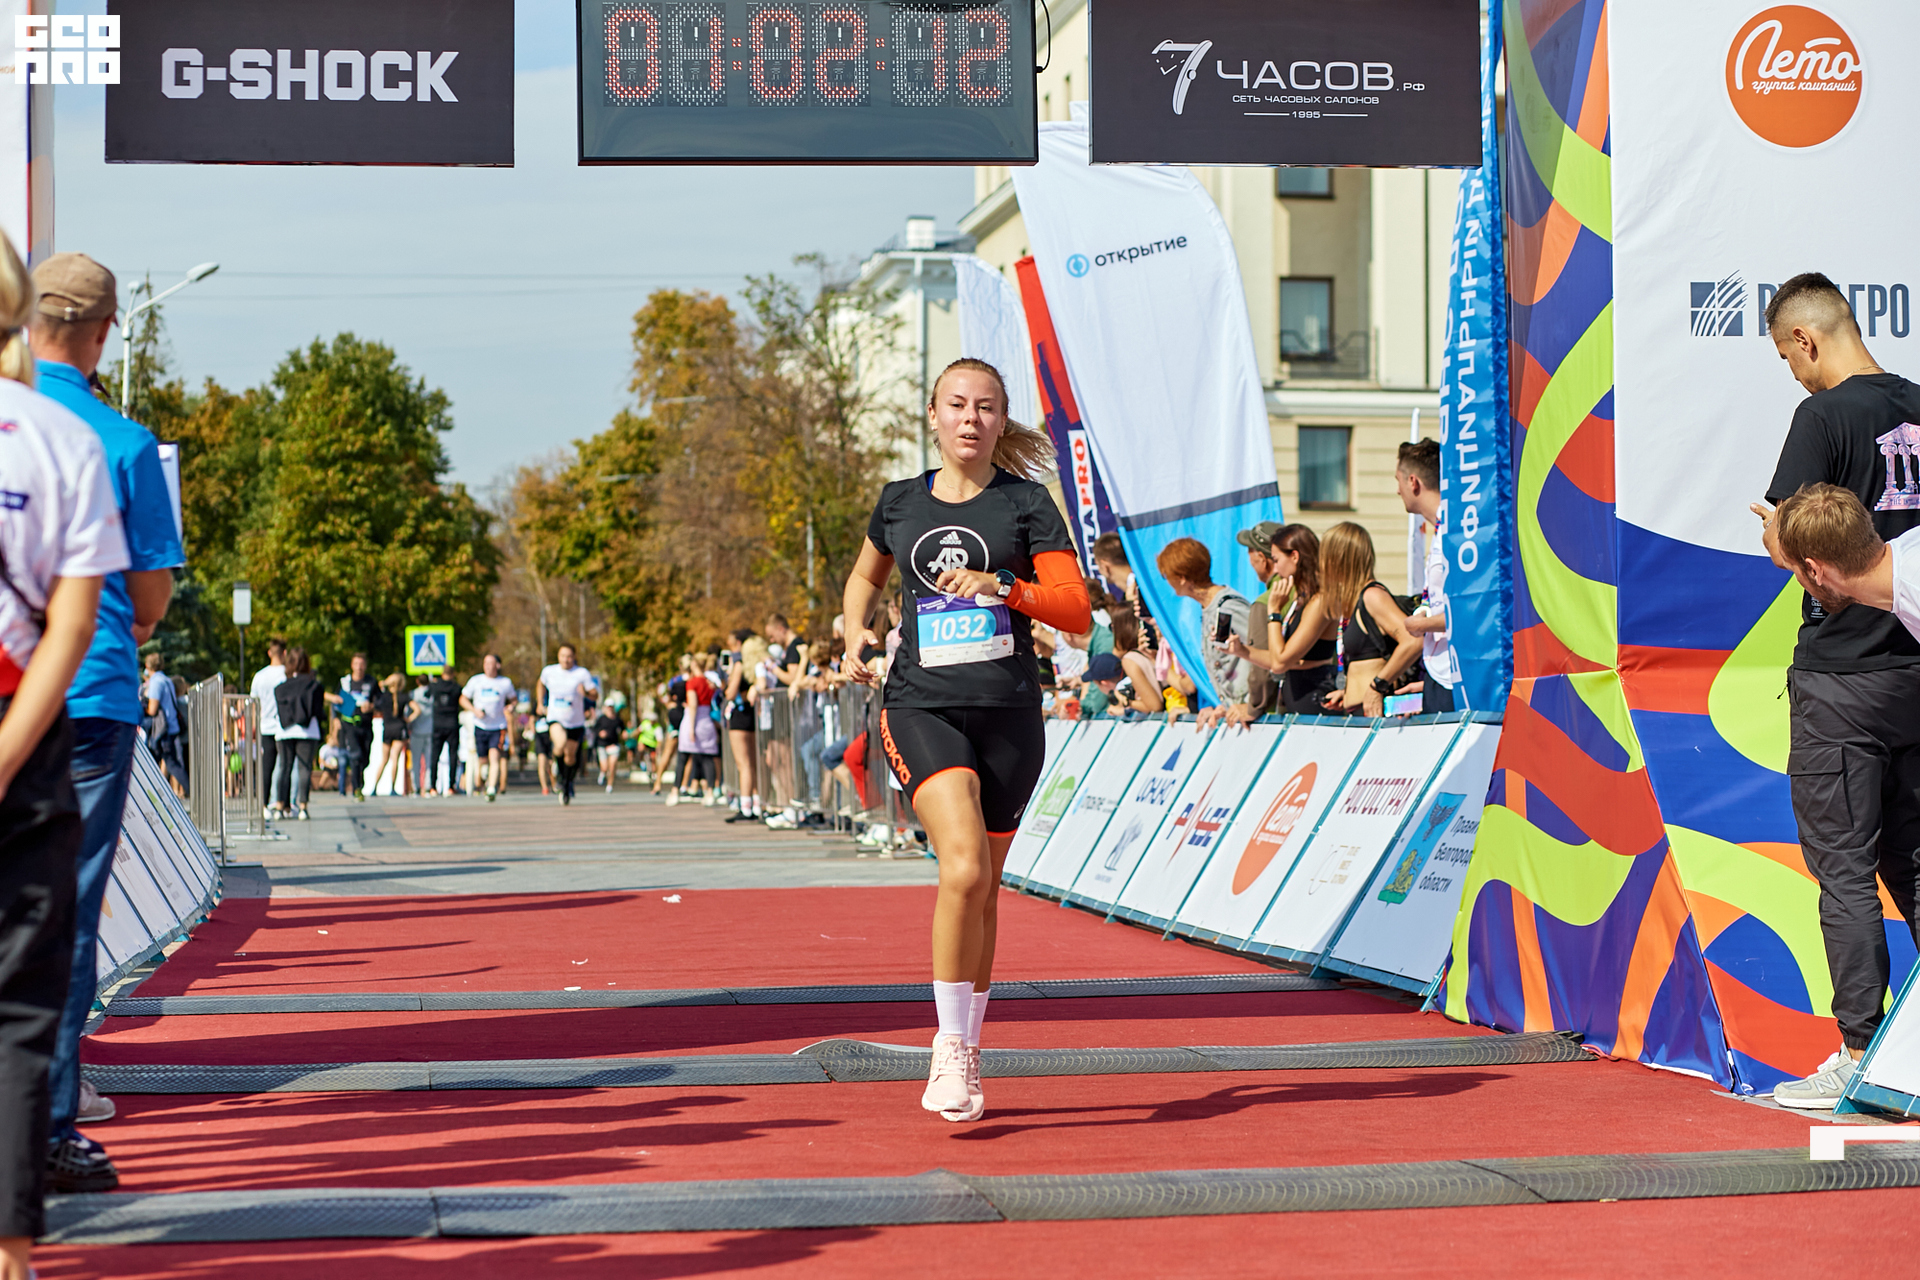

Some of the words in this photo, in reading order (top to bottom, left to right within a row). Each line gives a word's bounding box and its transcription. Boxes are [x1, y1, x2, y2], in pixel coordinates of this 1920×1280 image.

[605, 7, 1008, 104] 01:02:12
[1735, 20, 1863, 90] Лето
[162, 48, 459, 103] G-SHOCK
[1152, 39, 1213, 116] 7
[1752, 80, 1796, 95] группа
[1797, 80, 1857, 92] компаний
[1232, 94, 1261, 103] СЕТЬ
[1264, 95, 1321, 104] ЧАСОВЫХ
[1324, 96, 1380, 105] САЛОНОВ
[1292, 110, 1321, 119] 1995
[1095, 236, 1188, 271] открытие
[931, 613, 987, 643] 1032
[1450, 815, 1481, 837] Прави
[1418, 871, 1455, 893] области
